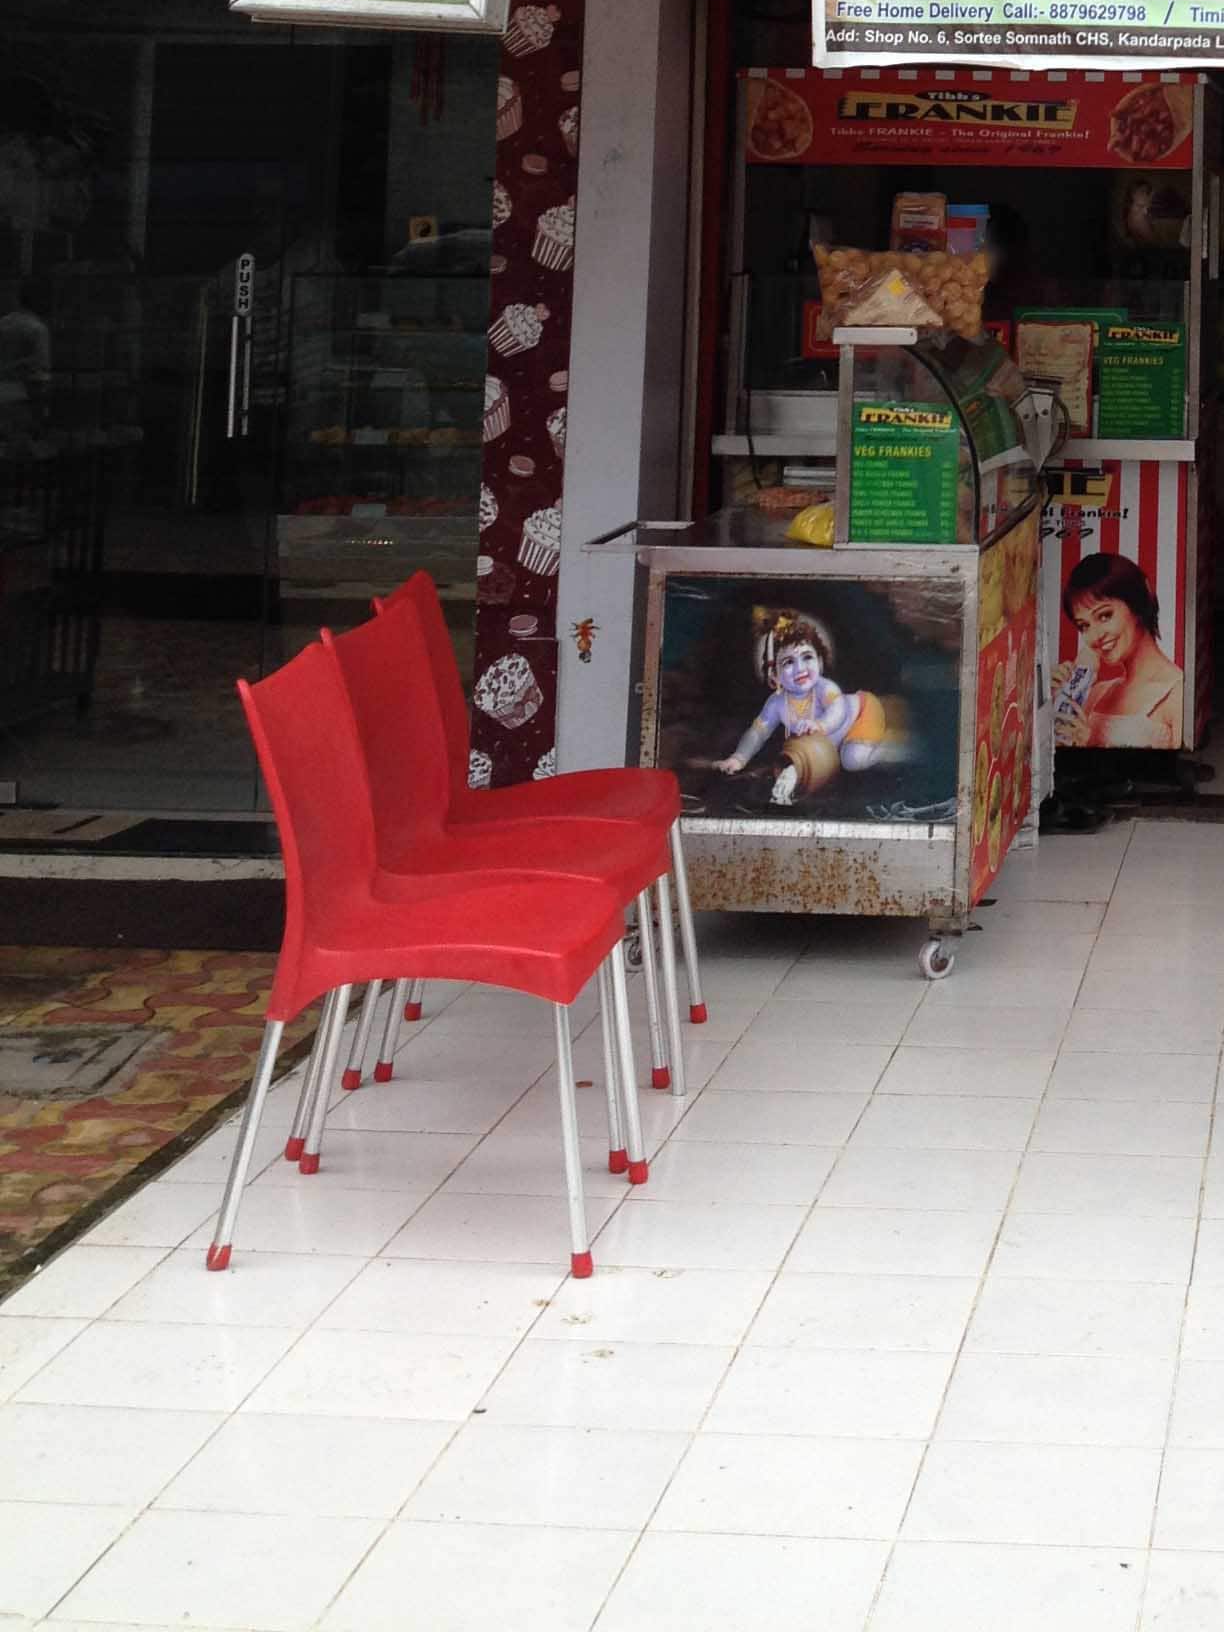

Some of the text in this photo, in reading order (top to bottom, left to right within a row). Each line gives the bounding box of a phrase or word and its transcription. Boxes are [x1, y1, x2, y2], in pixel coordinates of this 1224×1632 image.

[836, 1, 873, 18] Free
[878, 2, 925, 19] Home
[929, 2, 994, 22] Delivery
[1049, 3, 1147, 22] 8879629798
[824, 28, 860, 43] Add:
[864, 29, 904, 48] Shop
[908, 30, 933, 45] No.
[954, 31, 1001, 45] Sortee
[1005, 31, 1072, 46] Somnath
[1075, 32, 1114, 48] CHS,
[1117, 32, 1211, 50] Kandarpada
[855, 101, 1073, 122] FRANKIE
[868, 127, 934, 138] FRANKIE
[238, 259, 250, 309] PUSH
[854, 445, 932, 458] VEG FRANKIES
